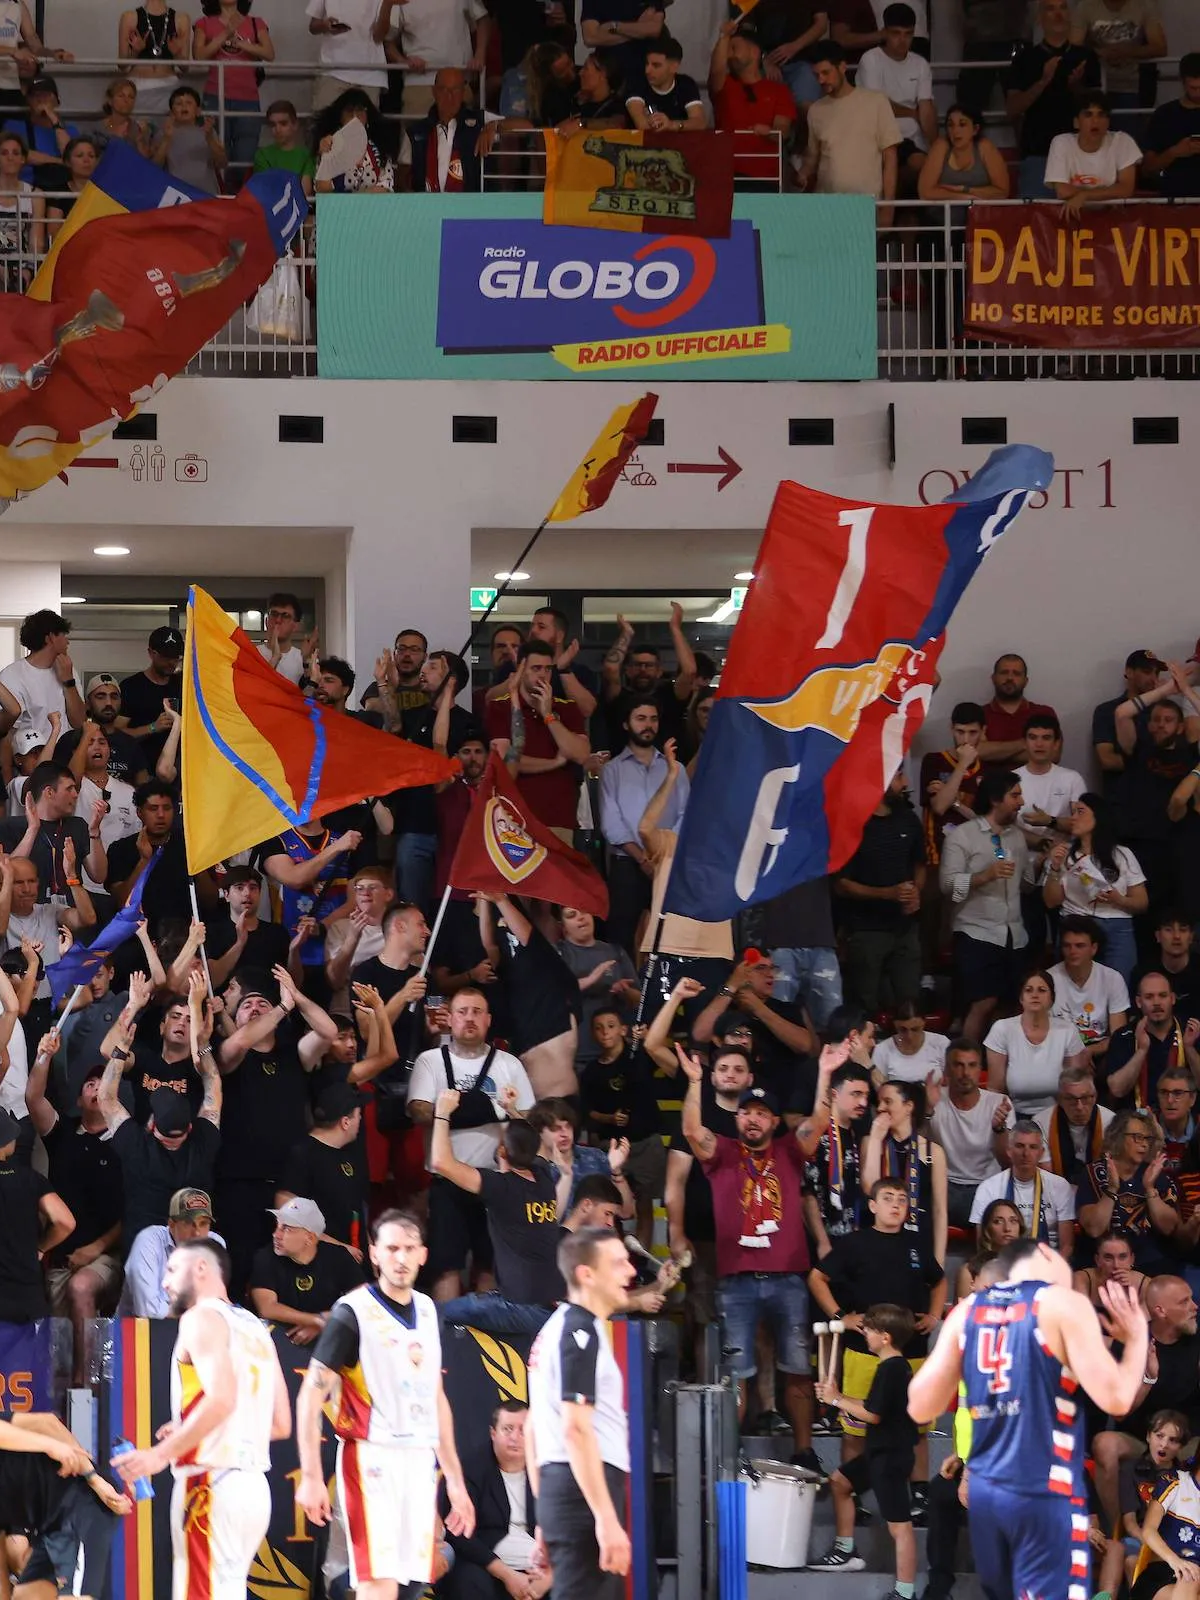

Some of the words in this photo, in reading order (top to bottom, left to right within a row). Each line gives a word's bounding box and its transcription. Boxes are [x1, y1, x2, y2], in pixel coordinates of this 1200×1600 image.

[483, 246, 526, 258] Radio
[972, 225, 1095, 289] DAJE
[478, 260, 681, 300] GLOBO
[969, 302, 1002, 323] HO
[1012, 303, 1104, 326] SEMPRE
[577, 341, 651, 366] RADIO
[655, 331, 768, 357] UFFICIALE
[1096, 458, 1118, 508] 1
[977, 1326, 1013, 1394] 4
